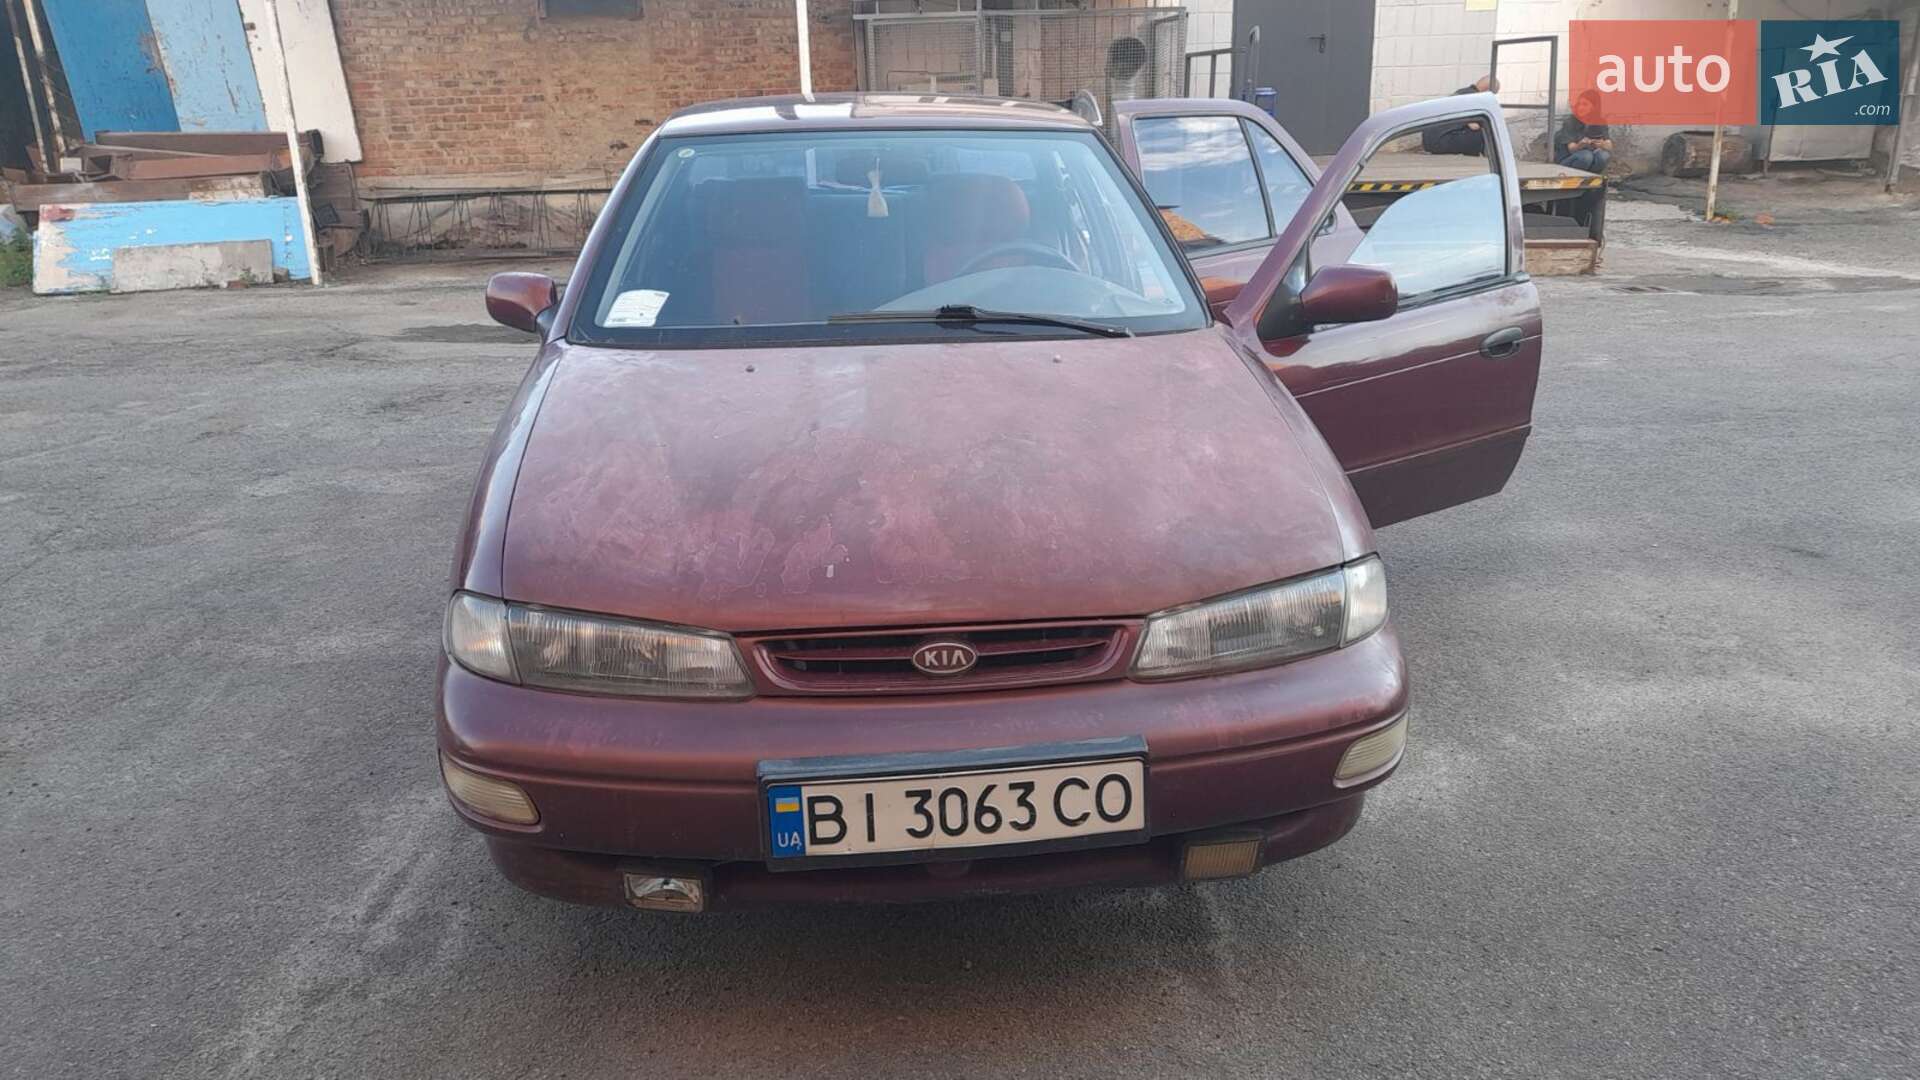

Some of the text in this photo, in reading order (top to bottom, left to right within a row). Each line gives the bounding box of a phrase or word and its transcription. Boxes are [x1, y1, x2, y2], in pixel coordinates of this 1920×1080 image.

[924, 650, 967, 666] KIA
[807, 773, 1133, 845] BI 3063 CO
[777, 832, 802, 849] UA
